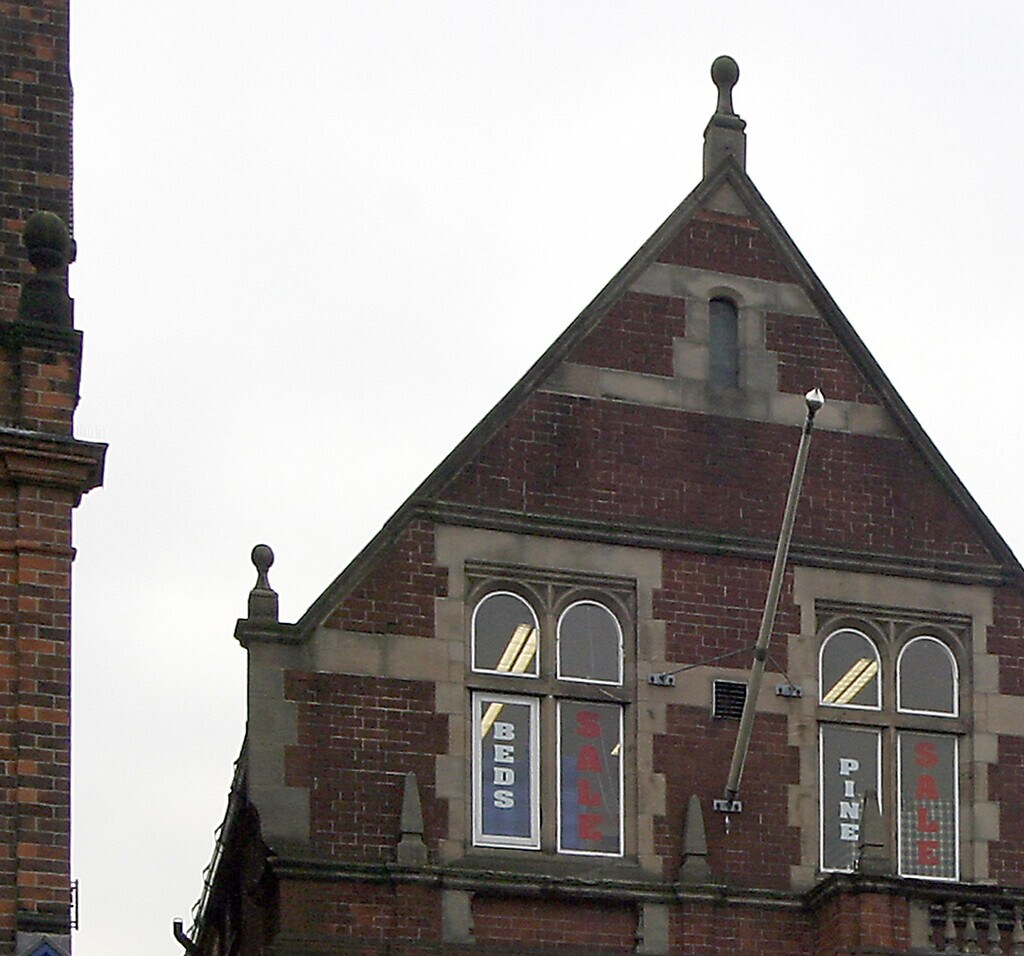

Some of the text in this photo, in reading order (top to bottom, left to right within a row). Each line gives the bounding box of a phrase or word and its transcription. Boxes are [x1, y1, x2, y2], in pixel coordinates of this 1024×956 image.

[493, 722, 515, 809] BEDS
[575, 711, 602, 840] SALE
[839, 758, 859, 841] PINE
[915, 742, 940, 865] SALE
